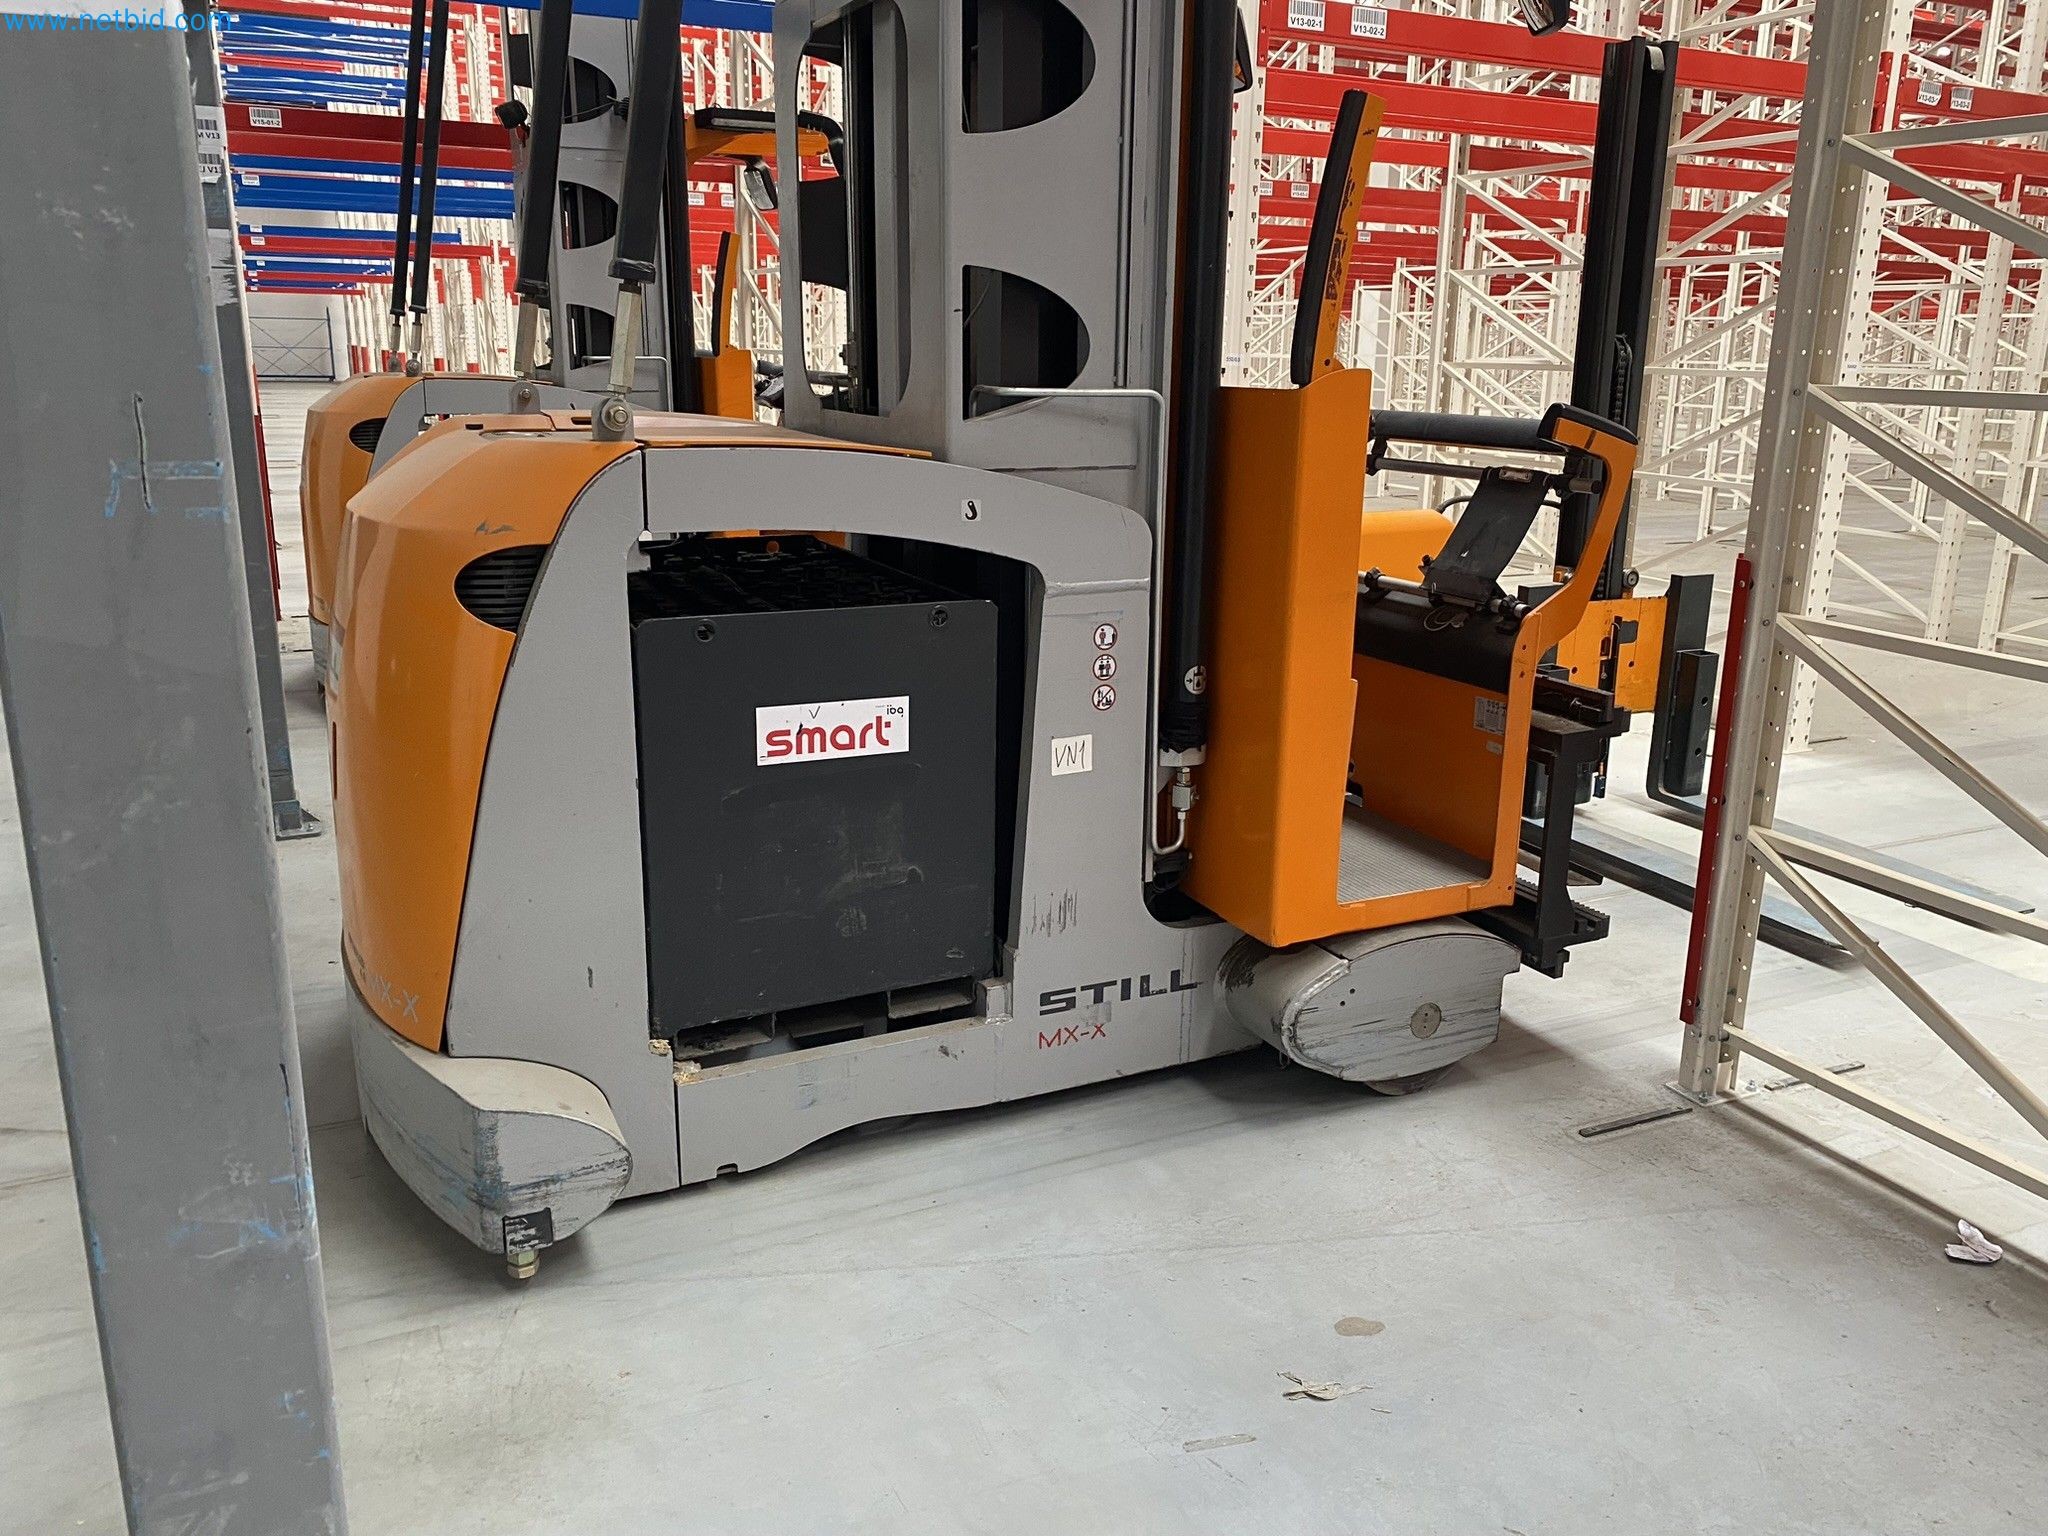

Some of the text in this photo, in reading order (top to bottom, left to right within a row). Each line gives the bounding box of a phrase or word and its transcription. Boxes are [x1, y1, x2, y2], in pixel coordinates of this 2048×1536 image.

[1290, 16, 1322, 28] V13-02-1
[1353, 24, 1385, 36] V13-02-2
[252, 119, 281, 127] V15-01-2
[205, 132, 221, 140] V13
[765, 716, 892, 758] smart
[1055, 740, 1086, 769] VN1
[1039, 969, 1198, 1016] STILL
[1038, 1023, 1107, 1050] MX-X
